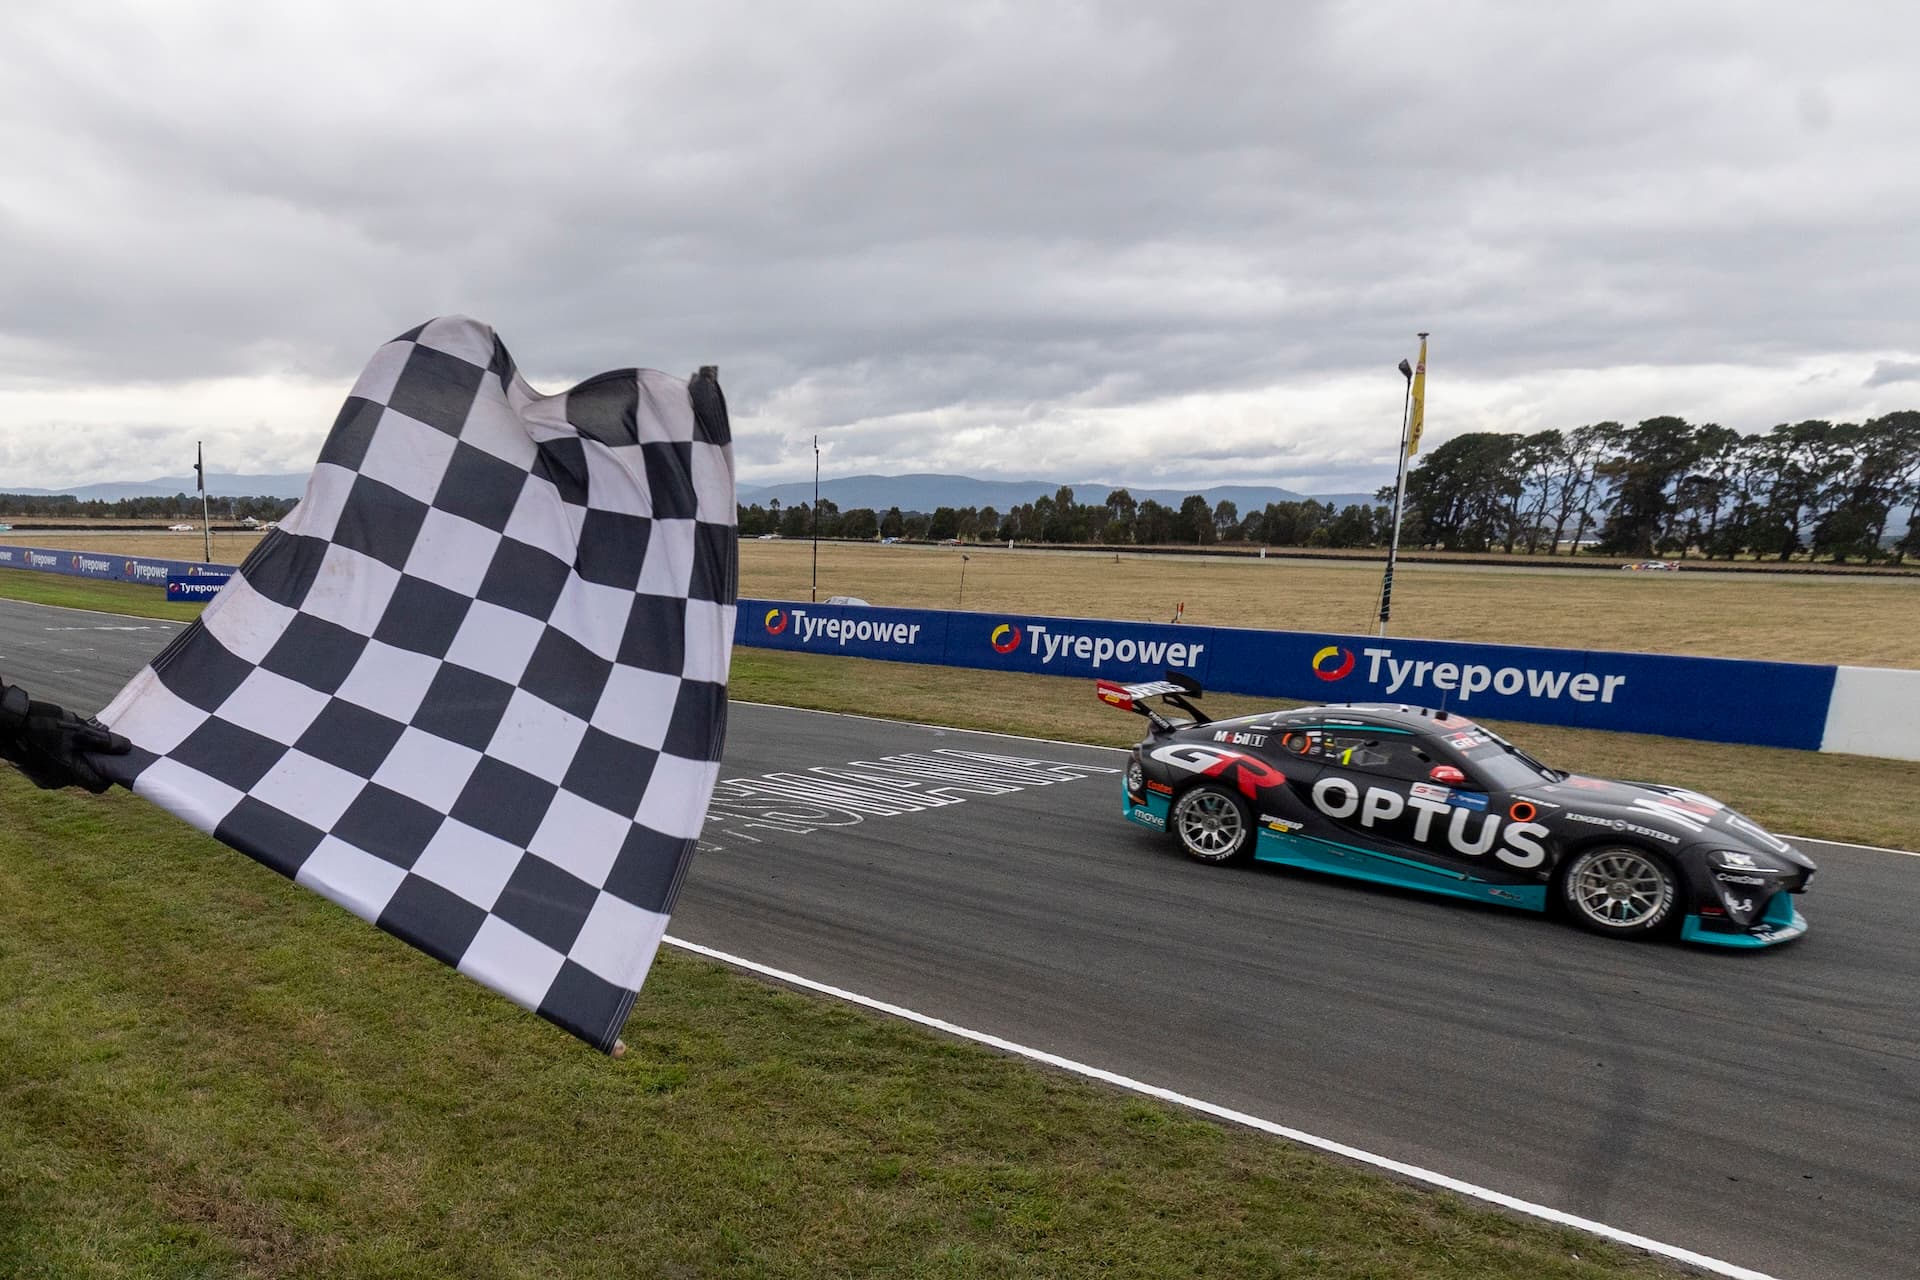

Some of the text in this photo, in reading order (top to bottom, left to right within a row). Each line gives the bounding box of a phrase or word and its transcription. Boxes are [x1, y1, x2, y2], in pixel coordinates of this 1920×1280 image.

[79, 555, 110, 573] Tyrepower
[133, 560, 168, 580] Tyrepower
[180, 583, 224, 595] Tyrepowe
[791, 609, 921, 646] Tyrepower
[1026, 624, 1204, 668] Tyrepower
[1363, 647, 1626, 703] Tyrepower
[1213, 730, 1251, 745] Mobil
[1149, 743, 1287, 801] GR
[1134, 809, 1165, 826] move
[1311, 776, 1551, 869] OPTUS
[1627, 822, 1681, 844] WESTERN
